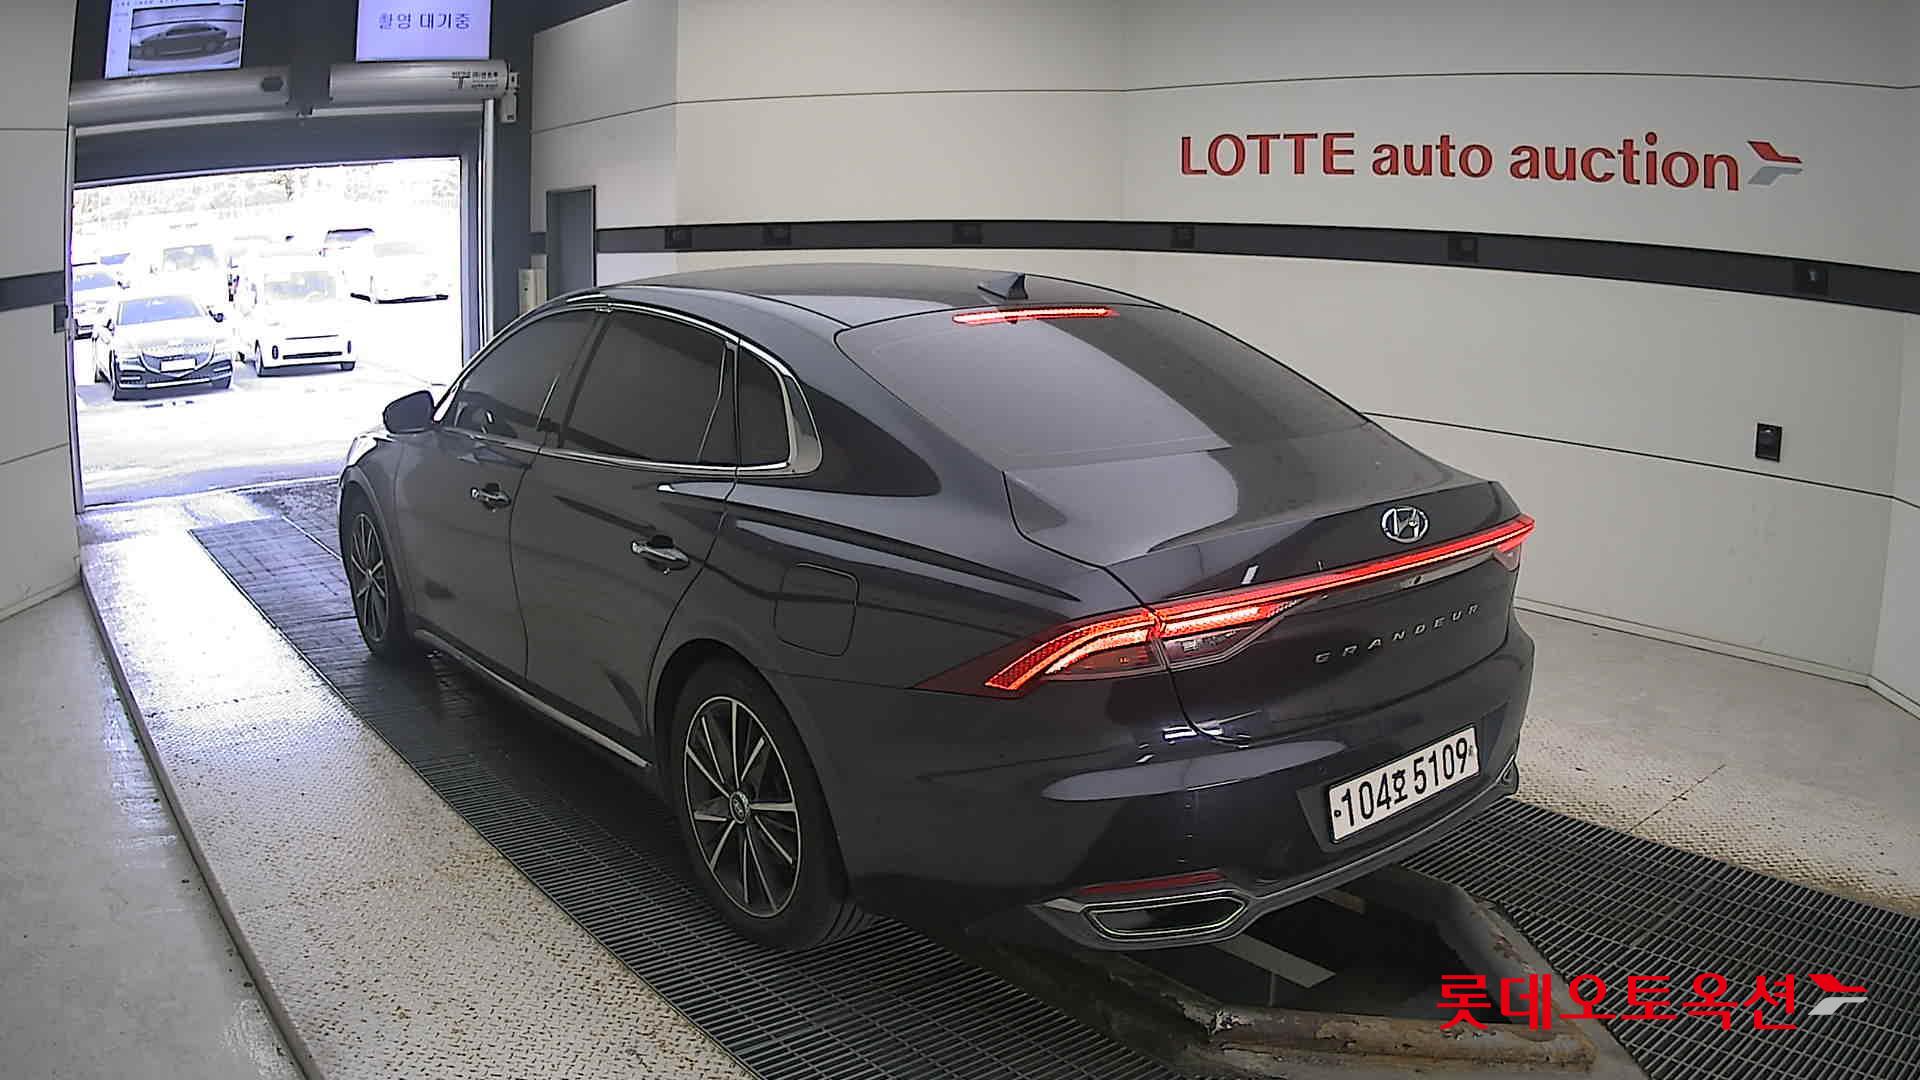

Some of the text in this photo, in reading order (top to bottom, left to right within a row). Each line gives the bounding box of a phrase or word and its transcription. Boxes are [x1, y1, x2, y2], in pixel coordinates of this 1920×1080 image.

[419, 12, 471, 30] 대기중
[1181, 131, 1739, 191] LOTTE auto auction
[1315, 603, 1479, 664] GRANDEUR
